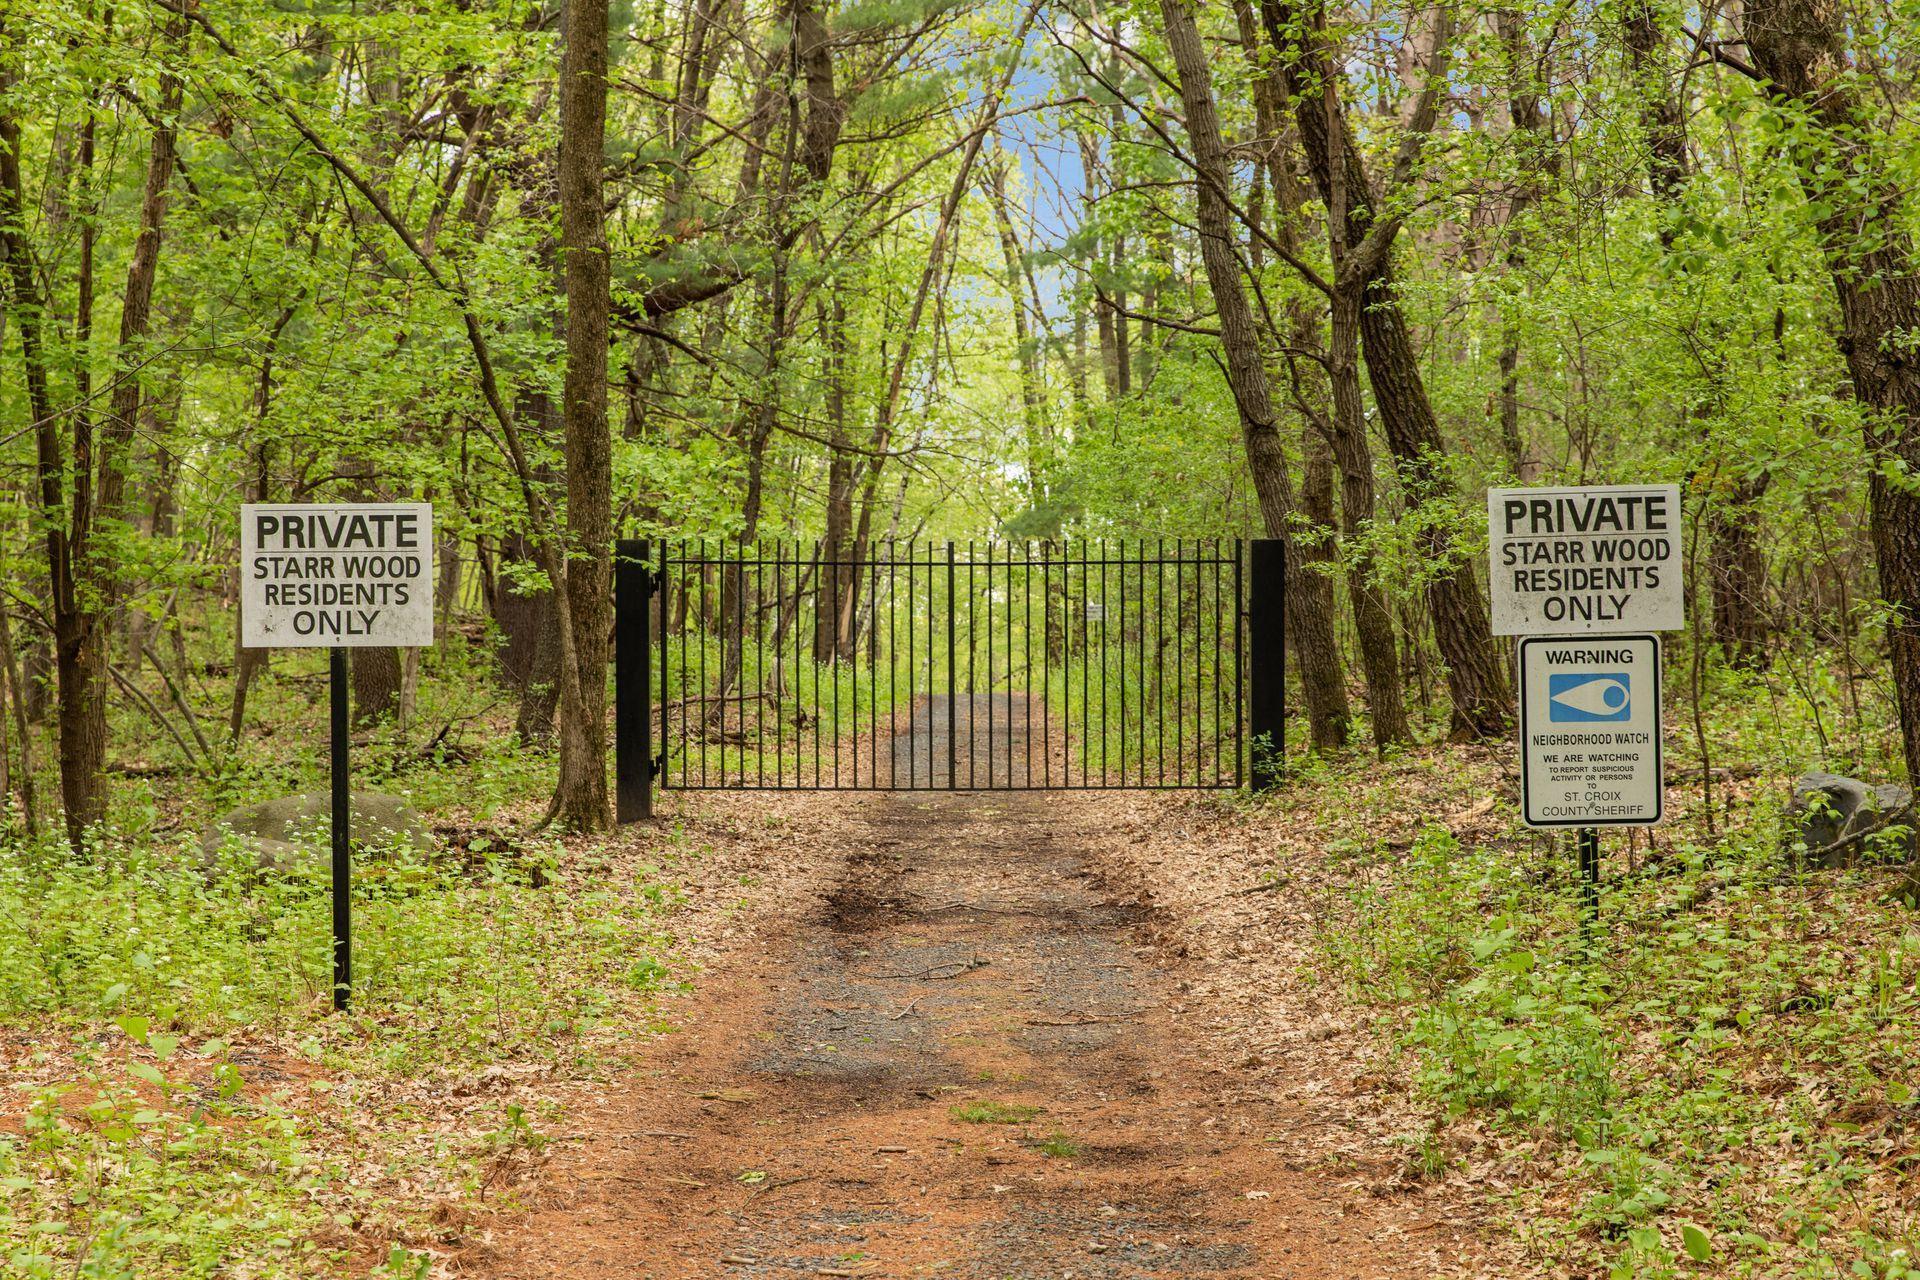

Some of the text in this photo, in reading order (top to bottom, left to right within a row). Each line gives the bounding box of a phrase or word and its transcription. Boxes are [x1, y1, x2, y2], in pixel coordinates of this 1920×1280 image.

[1504, 496, 1666, 534] PRIVATE
[257, 515, 417, 548] PRIVATE
[1503, 539, 1670, 565] STARR WOOD
[254, 556, 420, 579] STARR WOOD
[1515, 566, 1659, 592] RESIDENTS
[265, 583, 409, 606] RESIDENTS
[1544, 595, 1630, 621] ONLY
[293, 611, 380, 635] ONLY
[1545, 650, 1633, 664] WARNING
[1534, 733, 1648, 746] NEIGHBORHOOD WATCH
[1565, 792, 1621, 802] ST. CROIX
[1542, 806, 1643, 816] COUNTY SHERIFF
